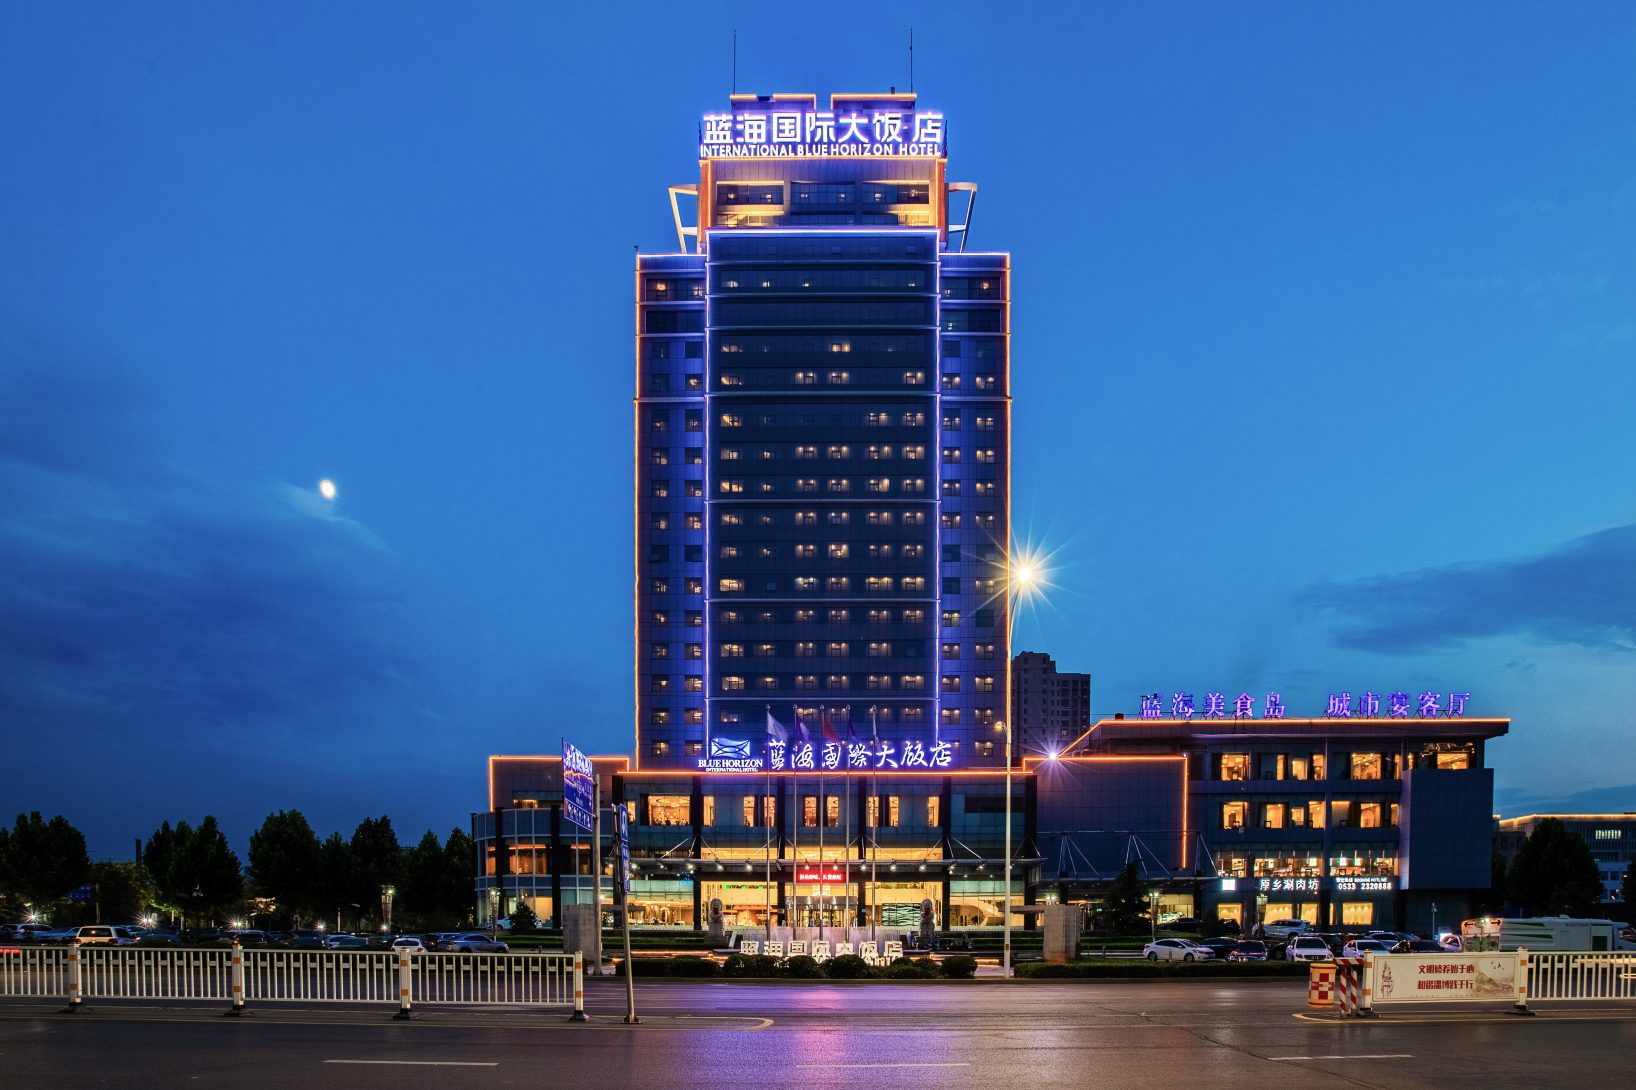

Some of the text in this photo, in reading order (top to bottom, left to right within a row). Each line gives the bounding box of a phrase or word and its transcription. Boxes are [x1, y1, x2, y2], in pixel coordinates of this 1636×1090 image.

[703, 112, 943, 144] 蓝海国际大饭店
[700, 144, 941, 157] INTERNATIONAL BLUE HORIZON HOTEL
[1140, 691, 1286, 719] 蓝海美食岛
[1327, 691, 1471, 718] 城市宴客厅
[698, 759, 763, 768] BLUE HORIZON
[1260, 879, 1320, 891] 原乡涮肉坊
[1338, 882, 1392, 891] 0533 2320888
[1418, 964, 1475, 974] 文明修养始于心
[1417, 979, 1474, 990] 和谐淄博践于行
